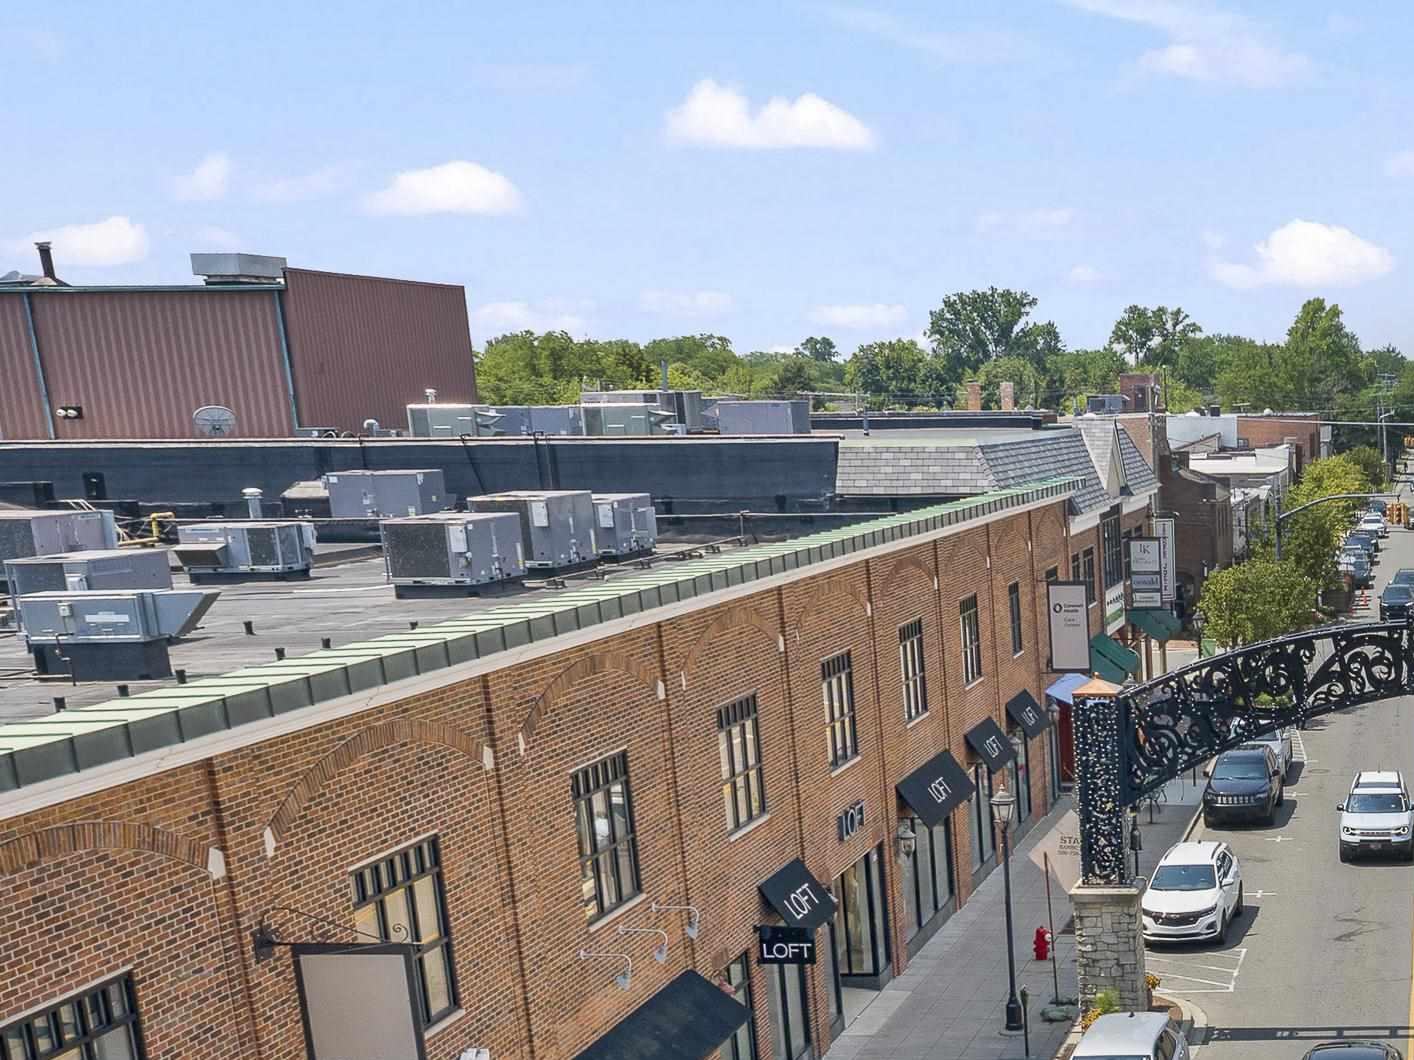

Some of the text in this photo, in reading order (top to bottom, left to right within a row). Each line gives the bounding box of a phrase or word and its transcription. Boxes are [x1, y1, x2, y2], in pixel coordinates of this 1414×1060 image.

[1021, 706, 1039, 726] LOFT
[983, 735, 1004, 758] LOFT
[927, 776, 952, 803] LOFT
[838, 800, 866, 842] LOFT
[784, 882, 819, 920] LOFT
[763, 943, 812, 959] LOFT
